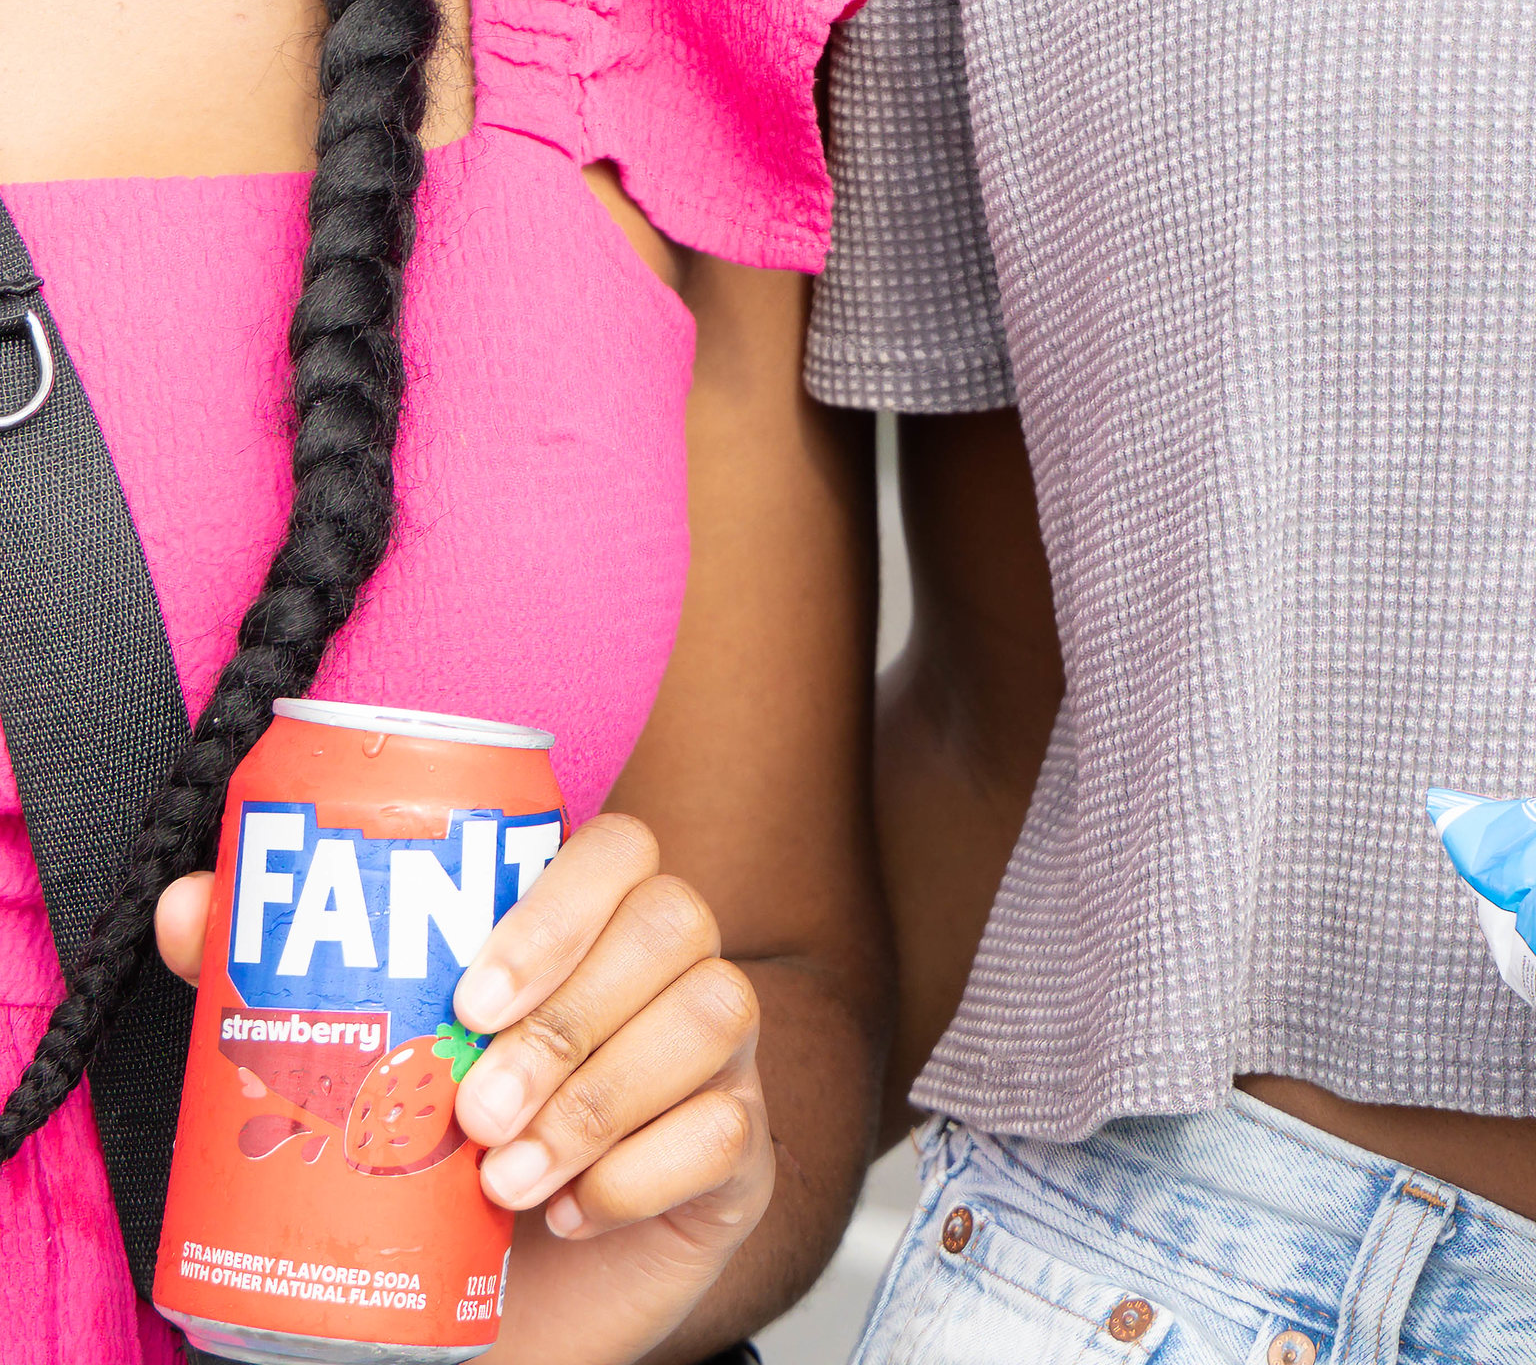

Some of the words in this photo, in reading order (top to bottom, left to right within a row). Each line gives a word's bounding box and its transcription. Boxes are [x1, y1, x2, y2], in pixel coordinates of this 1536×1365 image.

[233, 812, 562, 980] FANT
[221, 1013, 381, 1052] strawberry
[180, 1260, 210, 1282] WITH
[211, 1267, 263, 1292] OTHER
[264, 1277, 347, 1305] NATURAL
[349, 1287, 427, 1311] FLAVORS
[183, 1240, 277, 1275] STRAWBERRY
[276, 1258, 372, 1287] FLAVORED
[373, 1270, 421, 1291] SODA
[467, 1275, 479, 1297] 12
[487, 1273, 498, 1295] OZ
[456, 1298, 478, 1322] (355
